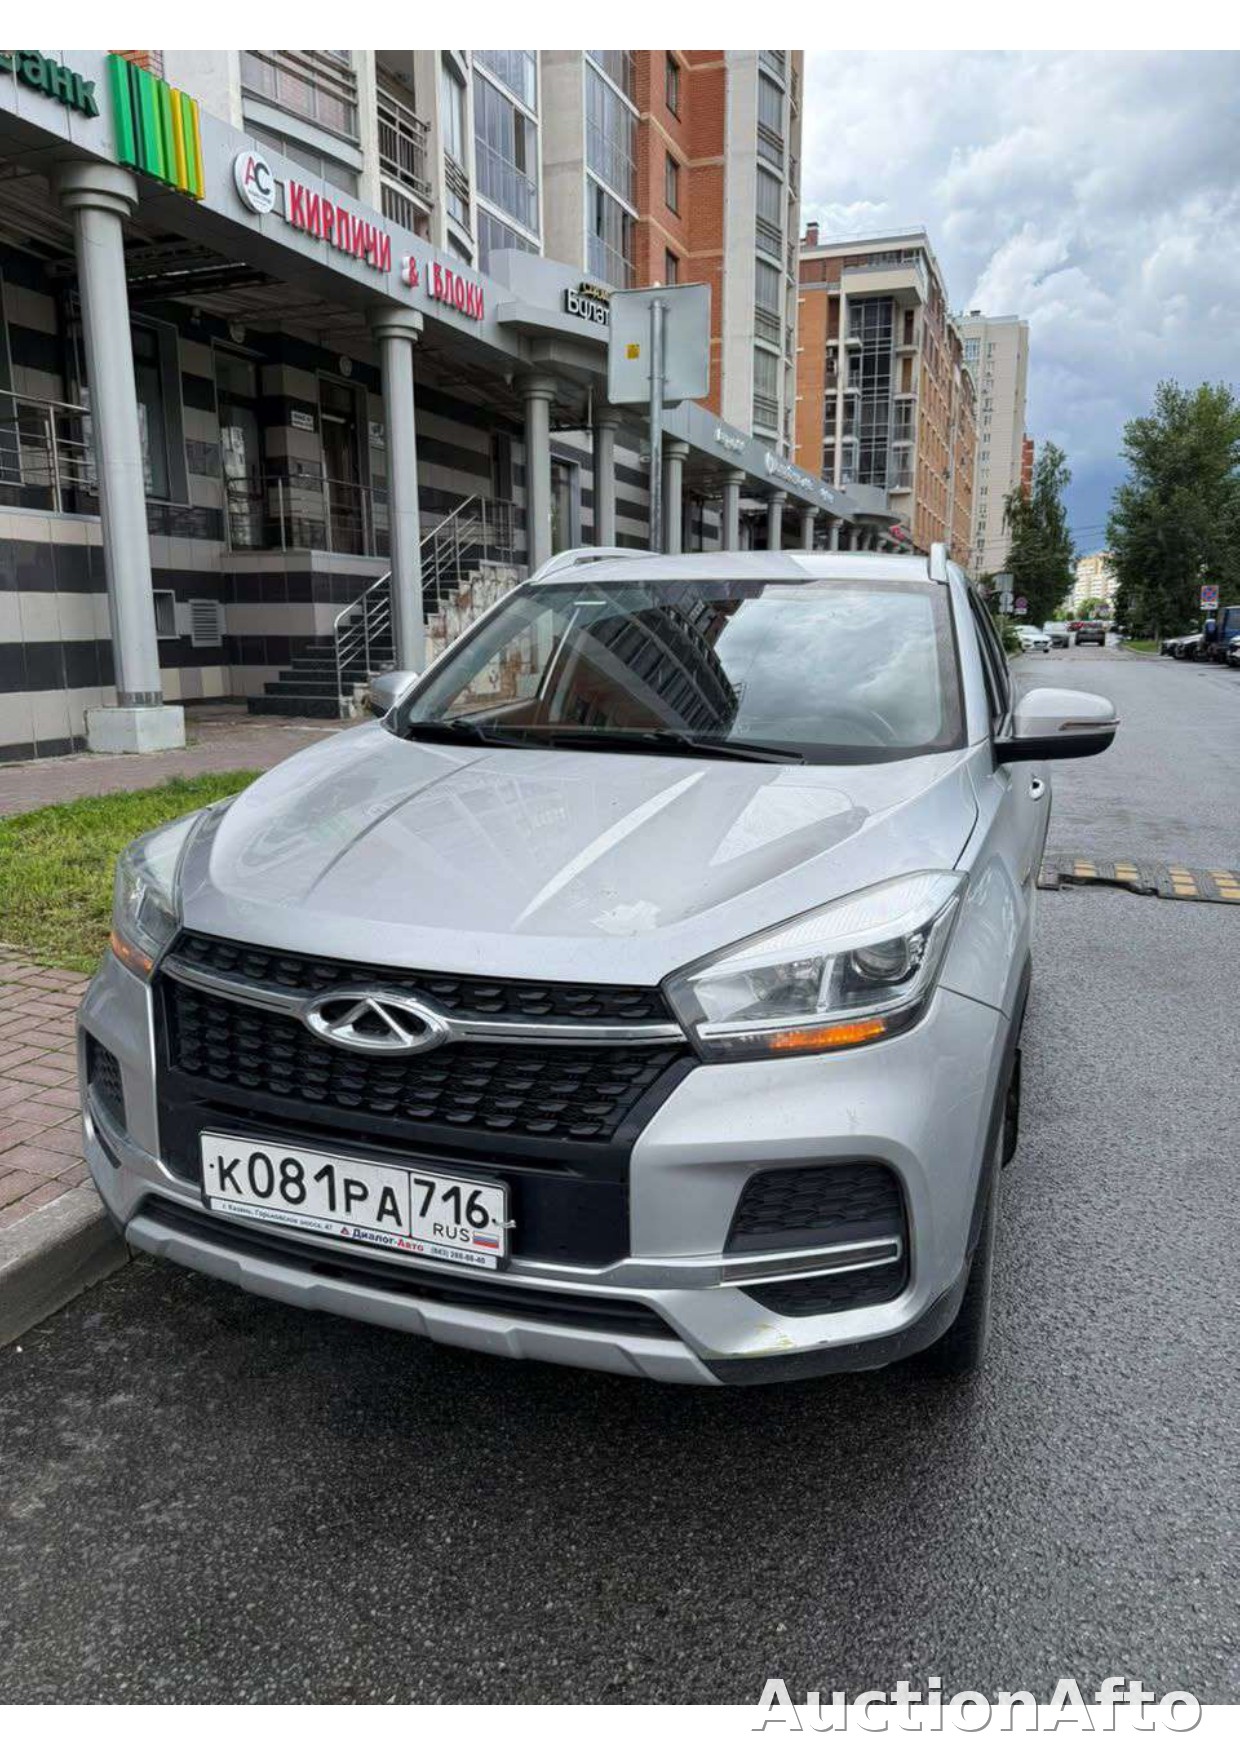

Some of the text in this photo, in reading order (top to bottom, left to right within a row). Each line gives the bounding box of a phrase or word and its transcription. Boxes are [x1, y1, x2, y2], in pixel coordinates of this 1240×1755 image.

[286, 180, 484, 321] КИРПИЧИ & БЛОКИ
[413, 1178, 490, 1230] 716
[352, 1228, 425, 1252] Диалог-Авто
[432, 1222, 471, 1243] RUS
